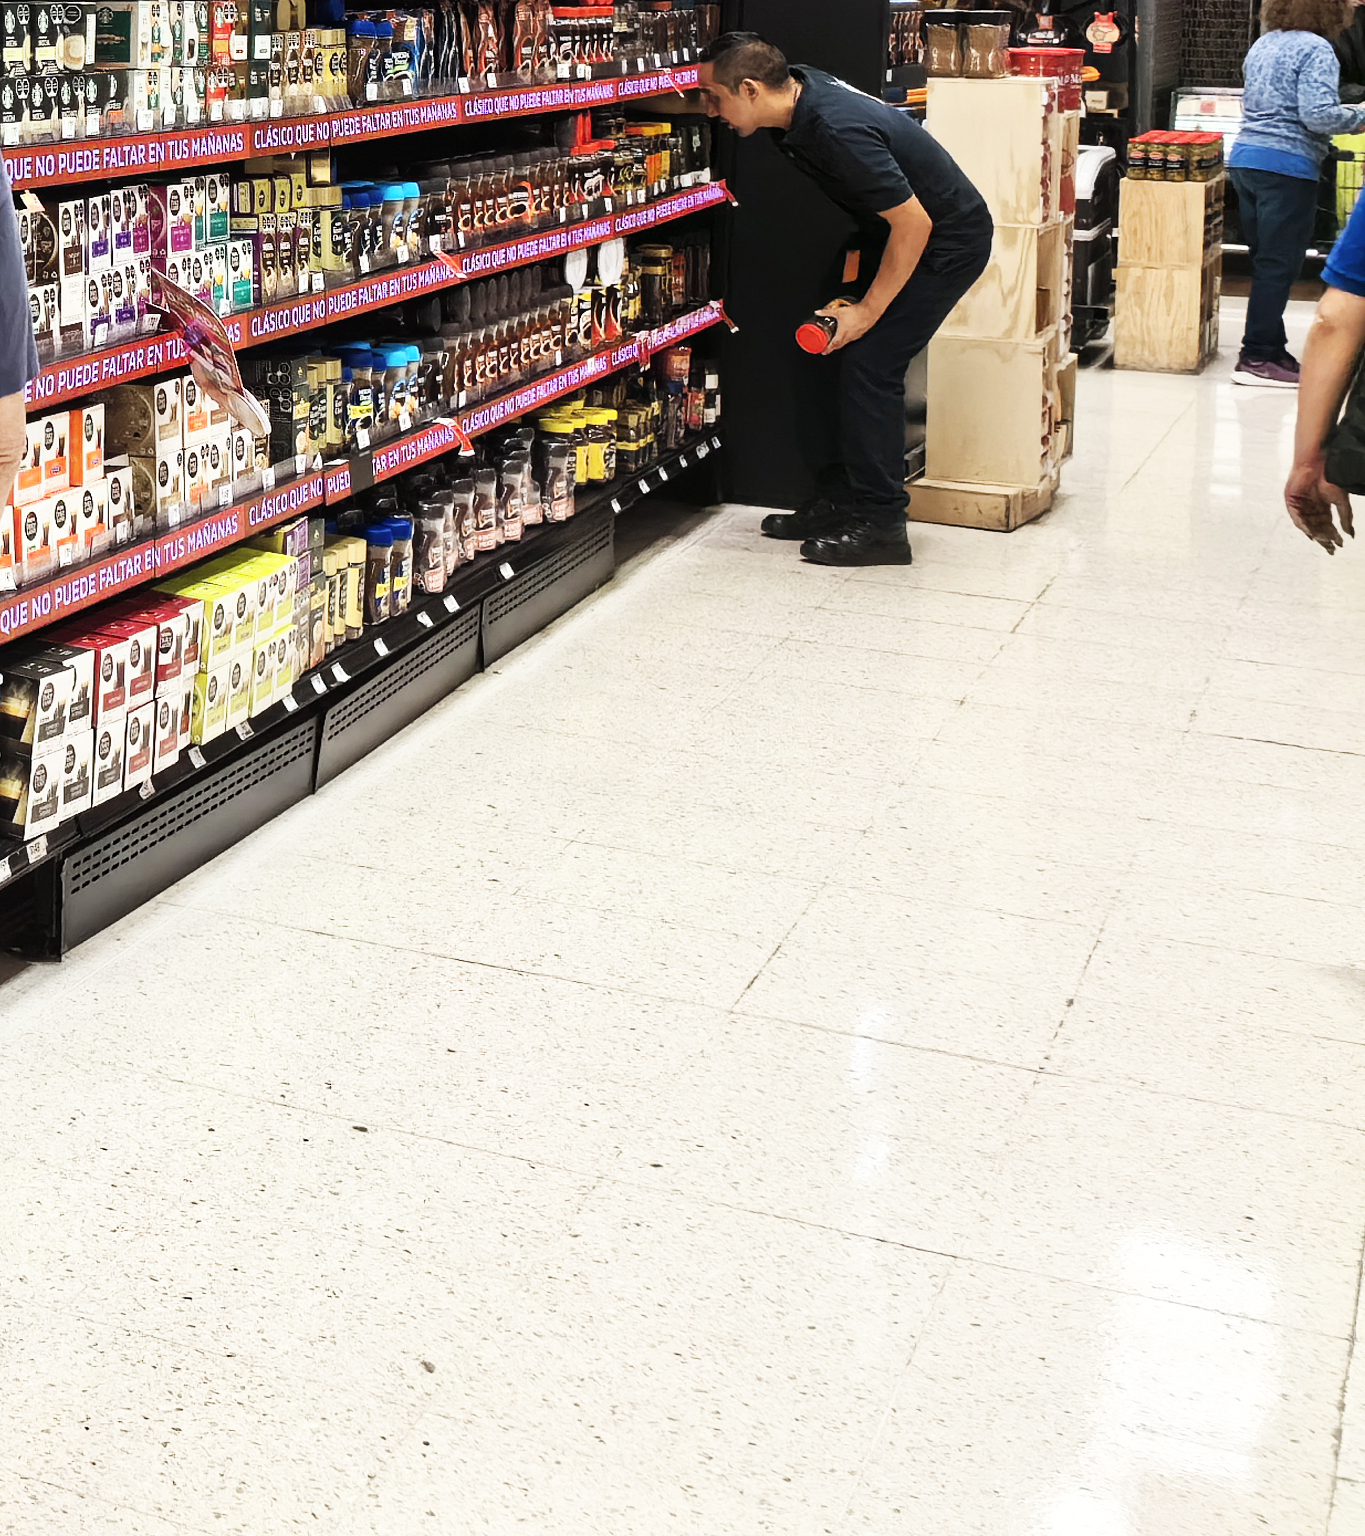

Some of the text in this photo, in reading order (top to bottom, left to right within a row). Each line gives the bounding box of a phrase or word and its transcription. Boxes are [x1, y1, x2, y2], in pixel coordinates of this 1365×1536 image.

[0, 606, 28, 636] QUE
[31, 596, 51, 618] NO
[55, 577, 96, 609] PUEDE
[99, 555, 141, 590] FALTAR
[145, 547, 161, 570] EN
[164, 535, 185, 563] TUS
[188, 516, 238, 554] MAÑANAS
